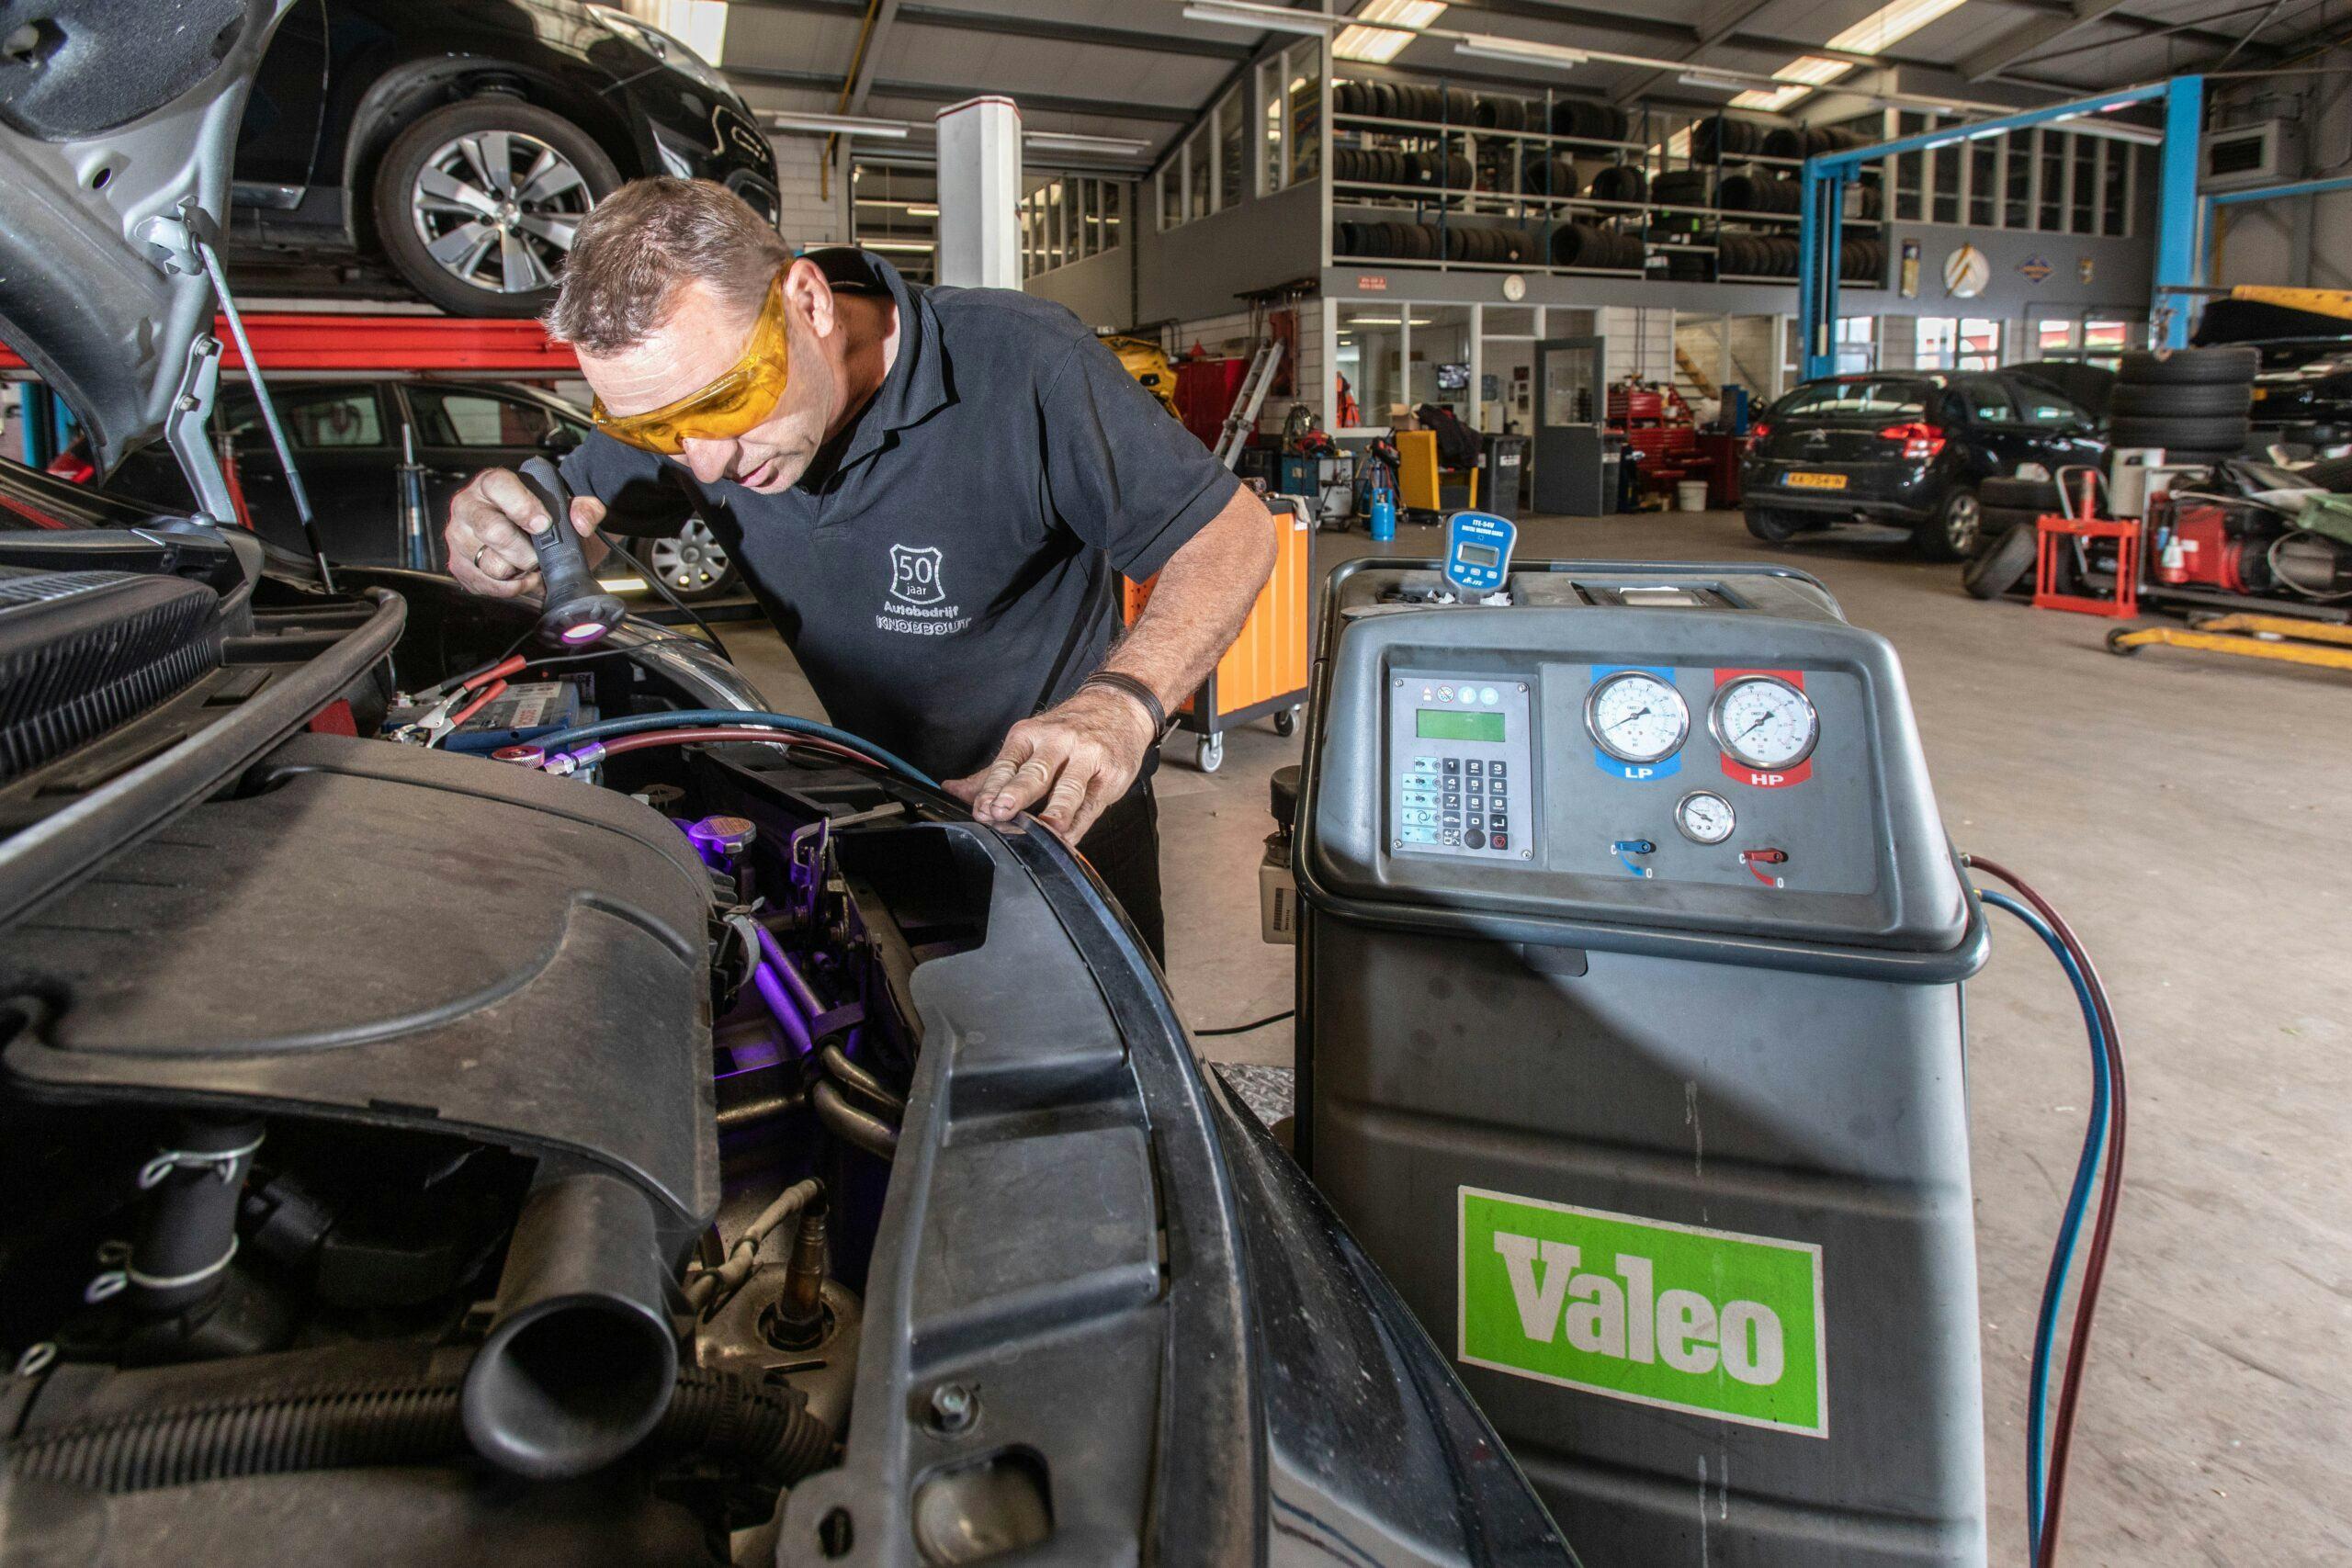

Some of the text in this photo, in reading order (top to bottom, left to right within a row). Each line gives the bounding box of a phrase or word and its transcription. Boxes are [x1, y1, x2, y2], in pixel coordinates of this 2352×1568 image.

[899, 555, 932, 583] 50
[906, 582, 927, 595] jaar
[883, 601, 959, 618] Autobedrijf
[1624, 767, 1653, 779] LP
[1751, 773, 1784, 785] HP
[1611, 844, 1618, 855] C
[1738, 853, 1747, 864] C
[1493, 1230, 1785, 1386] Valeo
